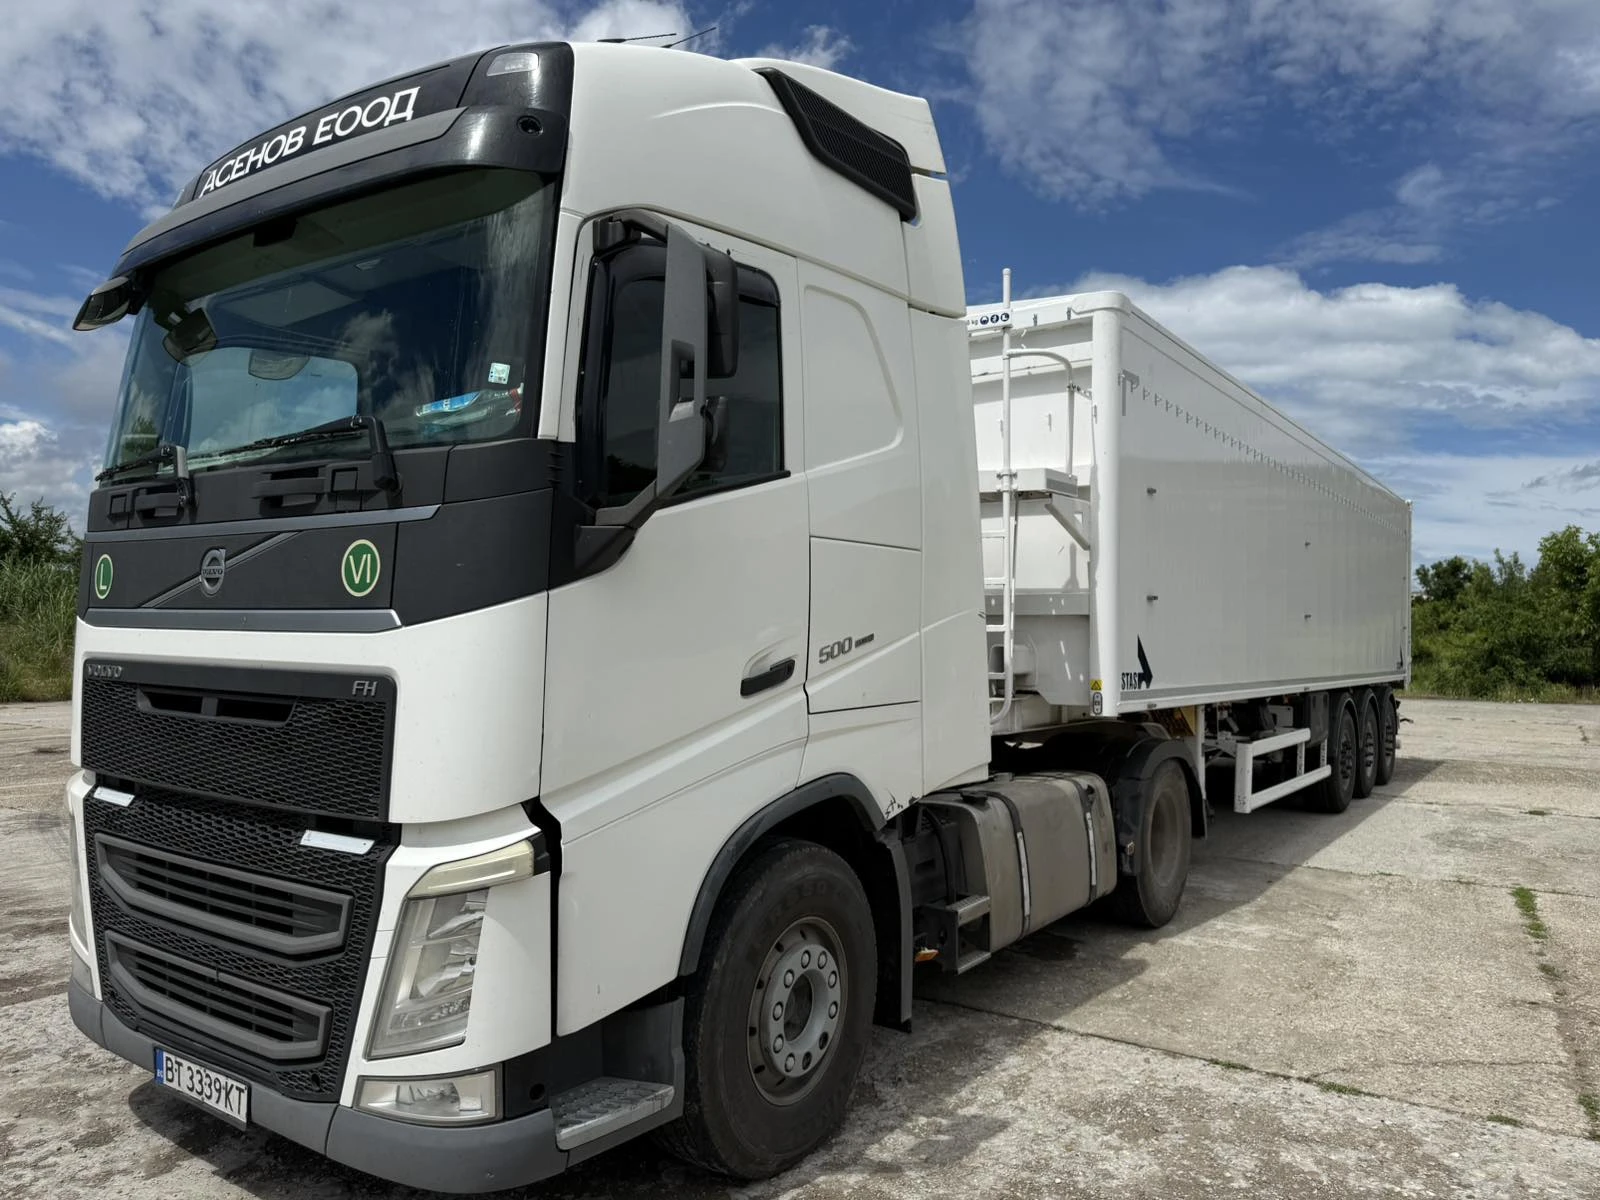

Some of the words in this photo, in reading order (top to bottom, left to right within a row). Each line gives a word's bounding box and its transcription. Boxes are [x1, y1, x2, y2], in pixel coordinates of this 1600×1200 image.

[199, 126, 307, 198] АСЕНОВ
[312, 86, 421, 146] ЕООД
[99, 562, 107, 590] L
[349, 554, 371, 585] VI
[818, 636, 853, 665] 500
[87, 663, 123, 678] VOLVO
[1121, 671, 1138, 690] STAS
[351, 680, 378, 696] FH
